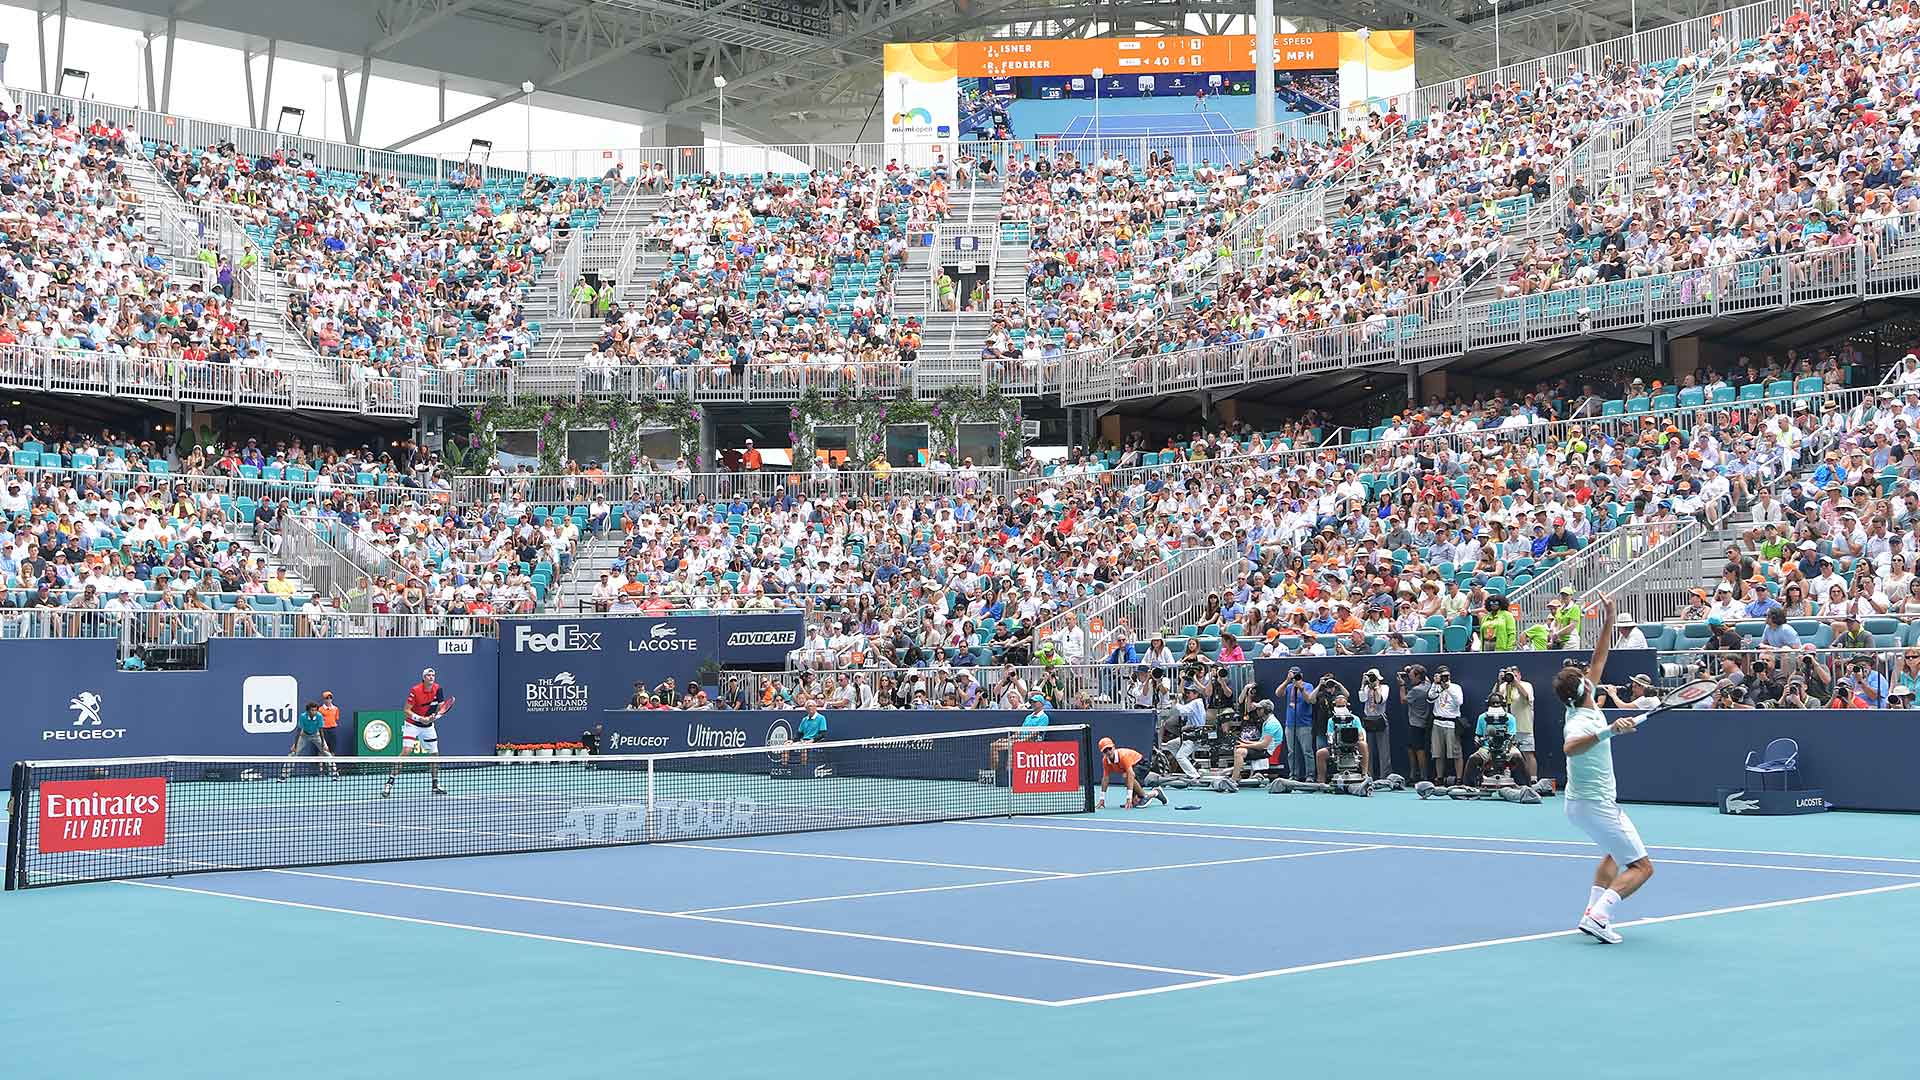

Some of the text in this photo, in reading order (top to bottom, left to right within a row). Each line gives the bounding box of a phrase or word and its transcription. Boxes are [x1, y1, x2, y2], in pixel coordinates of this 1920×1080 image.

[1000, 44, 1033, 53] ISNER
[1157, 40, 1166, 50] 0
[1283, 37, 1313, 46] SPEED
[1001, 60, 1051, 69] FEDERER
[1153, 56, 1170, 66] 40
[1178, 56, 1186, 66] 6
[1287, 51, 1315, 60] MPH
[515, 624, 602, 652] FedEx
[629, 638, 698, 652] LACOSTE
[727, 631, 797, 646] ADVOCARE
[444, 640, 469, 653] Itaú
[538, 678, 555, 686] THE
[526, 683, 589, 700] BRITISH
[526, 699, 588, 708] VIRGIN ISLANDS
[247, 703, 293, 724] Itaú
[42, 728, 127, 741] PEUGEOT
[620, 735, 670, 747] PEUGEOT
[686, 723, 747, 748] Ultimate
[1016, 750, 1076, 769] Emirates
[1025, 768, 1067, 784] FLY BETTER
[47, 791, 160, 818] Emirates
[1796, 797, 1823, 808] LACOSTE
[553, 797, 758, 839] ATP TOUR
[63, 817, 142, 840] FLY BETTER
